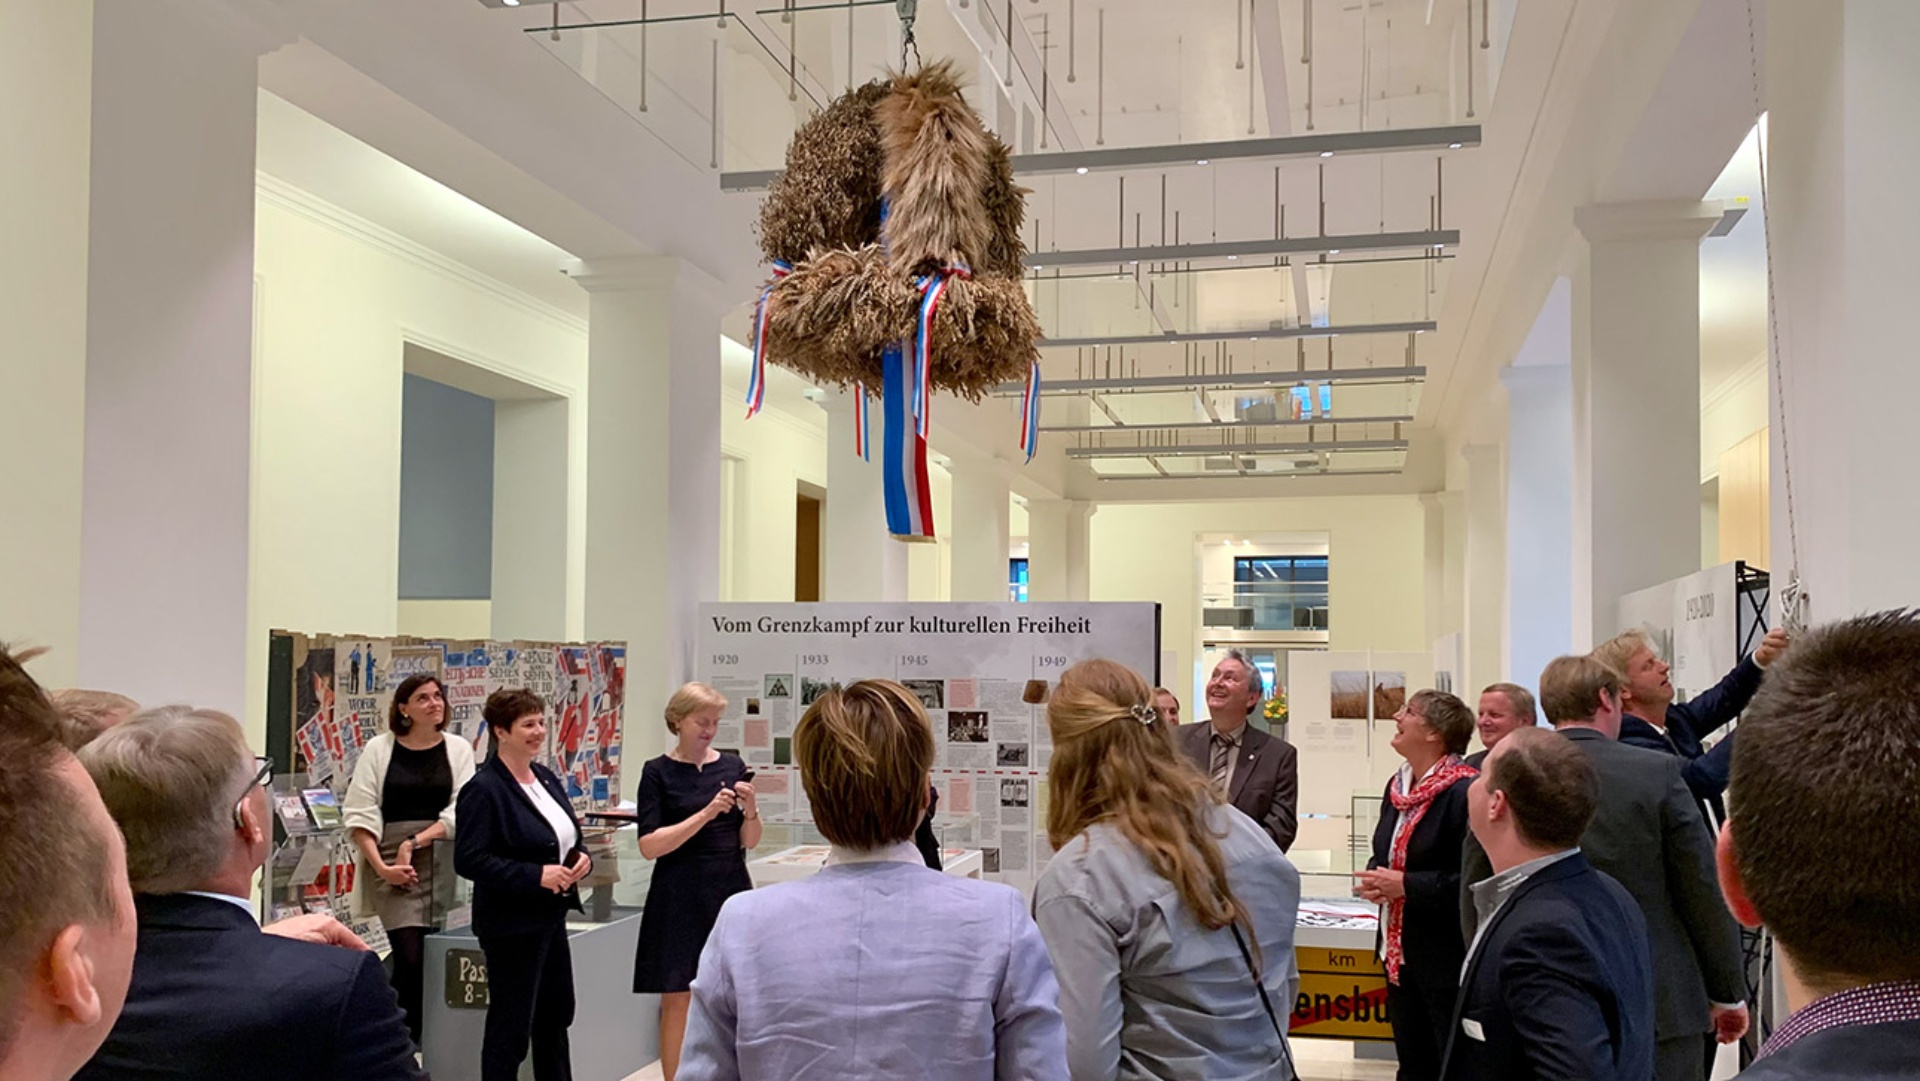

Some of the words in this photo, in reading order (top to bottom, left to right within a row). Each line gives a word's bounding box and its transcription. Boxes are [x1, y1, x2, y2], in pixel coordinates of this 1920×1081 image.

[712, 616, 752, 633] Vom
[757, 615, 872, 638] Grenzkampf
[874, 620, 905, 633] zur
[909, 615, 1011, 634] kulturellen
[1017, 616, 1092, 634] Freiheit
[712, 654, 739, 665] 1920
[802, 654, 829, 665] 1933
[901, 655, 928, 666] 1945
[1038, 656, 1067, 667] 1949
[1328, 951, 1356, 967] km
[459, 956, 488, 982] Pas
